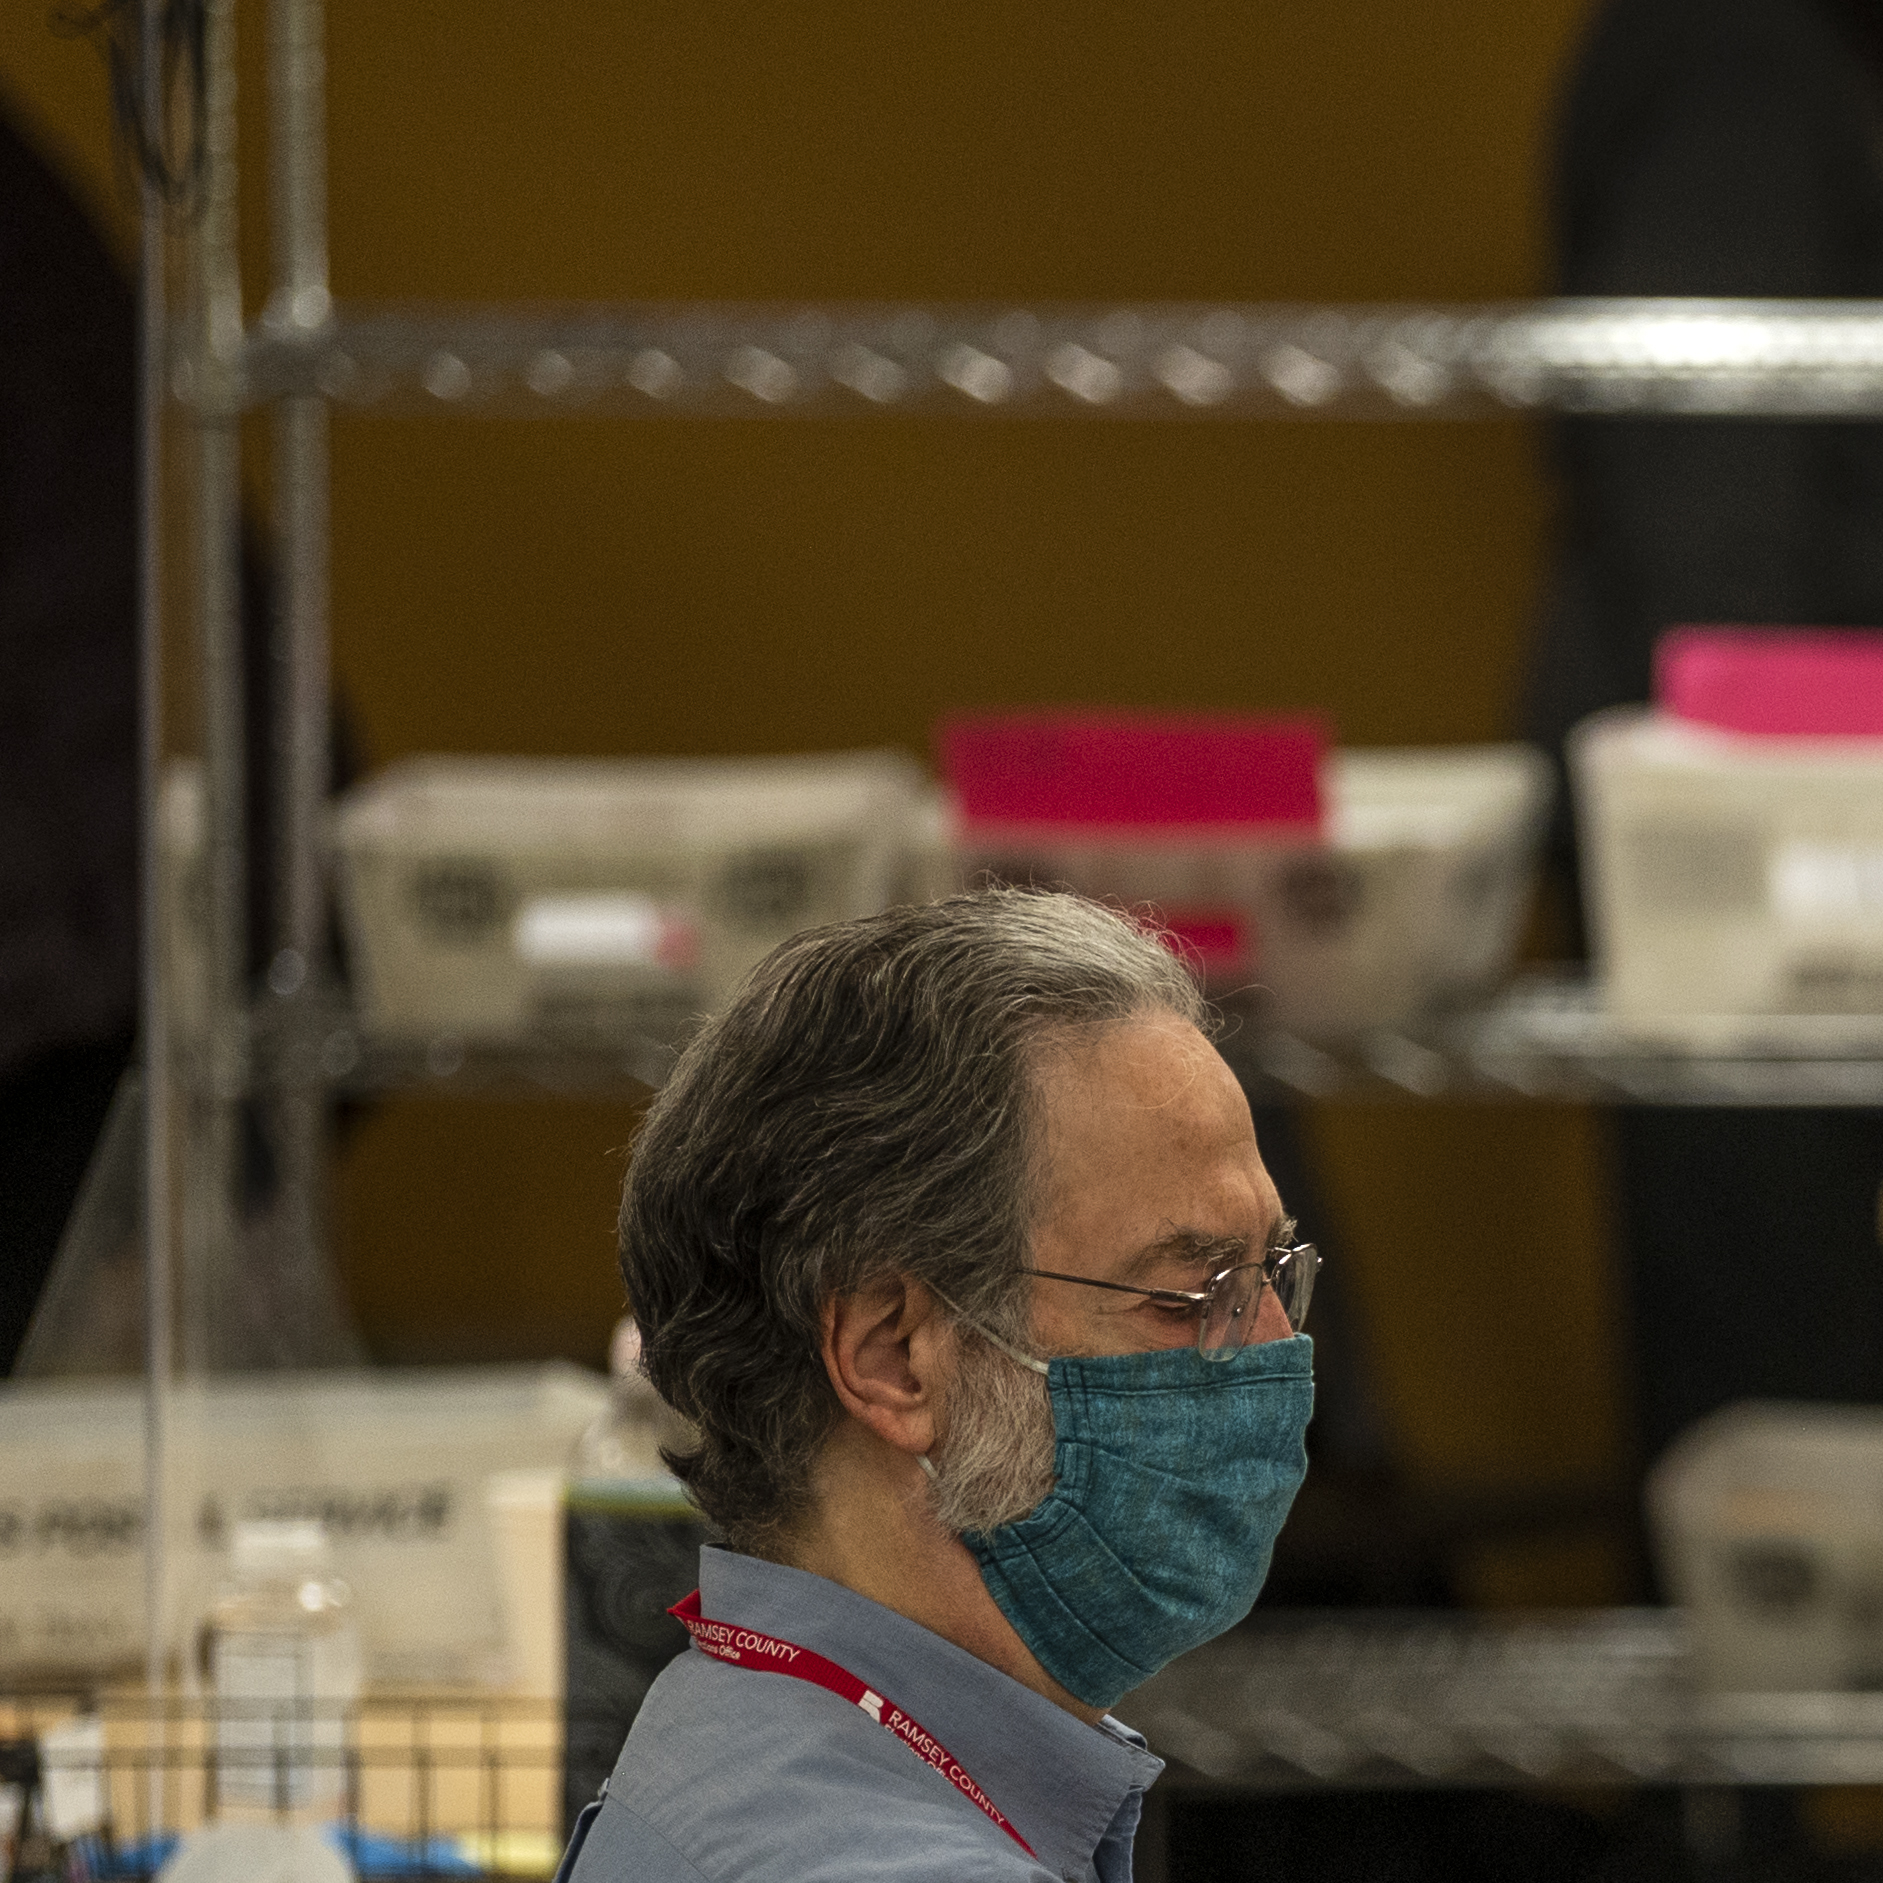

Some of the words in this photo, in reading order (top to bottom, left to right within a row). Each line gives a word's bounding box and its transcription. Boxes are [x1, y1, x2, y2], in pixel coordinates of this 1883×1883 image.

[686, 1619, 735, 1644] RAMSEY
[735, 1631, 801, 1663] COUNTY
[888, 1710, 950, 1766] RAMSEY
[949, 1765, 1004, 1825] COUNTY
